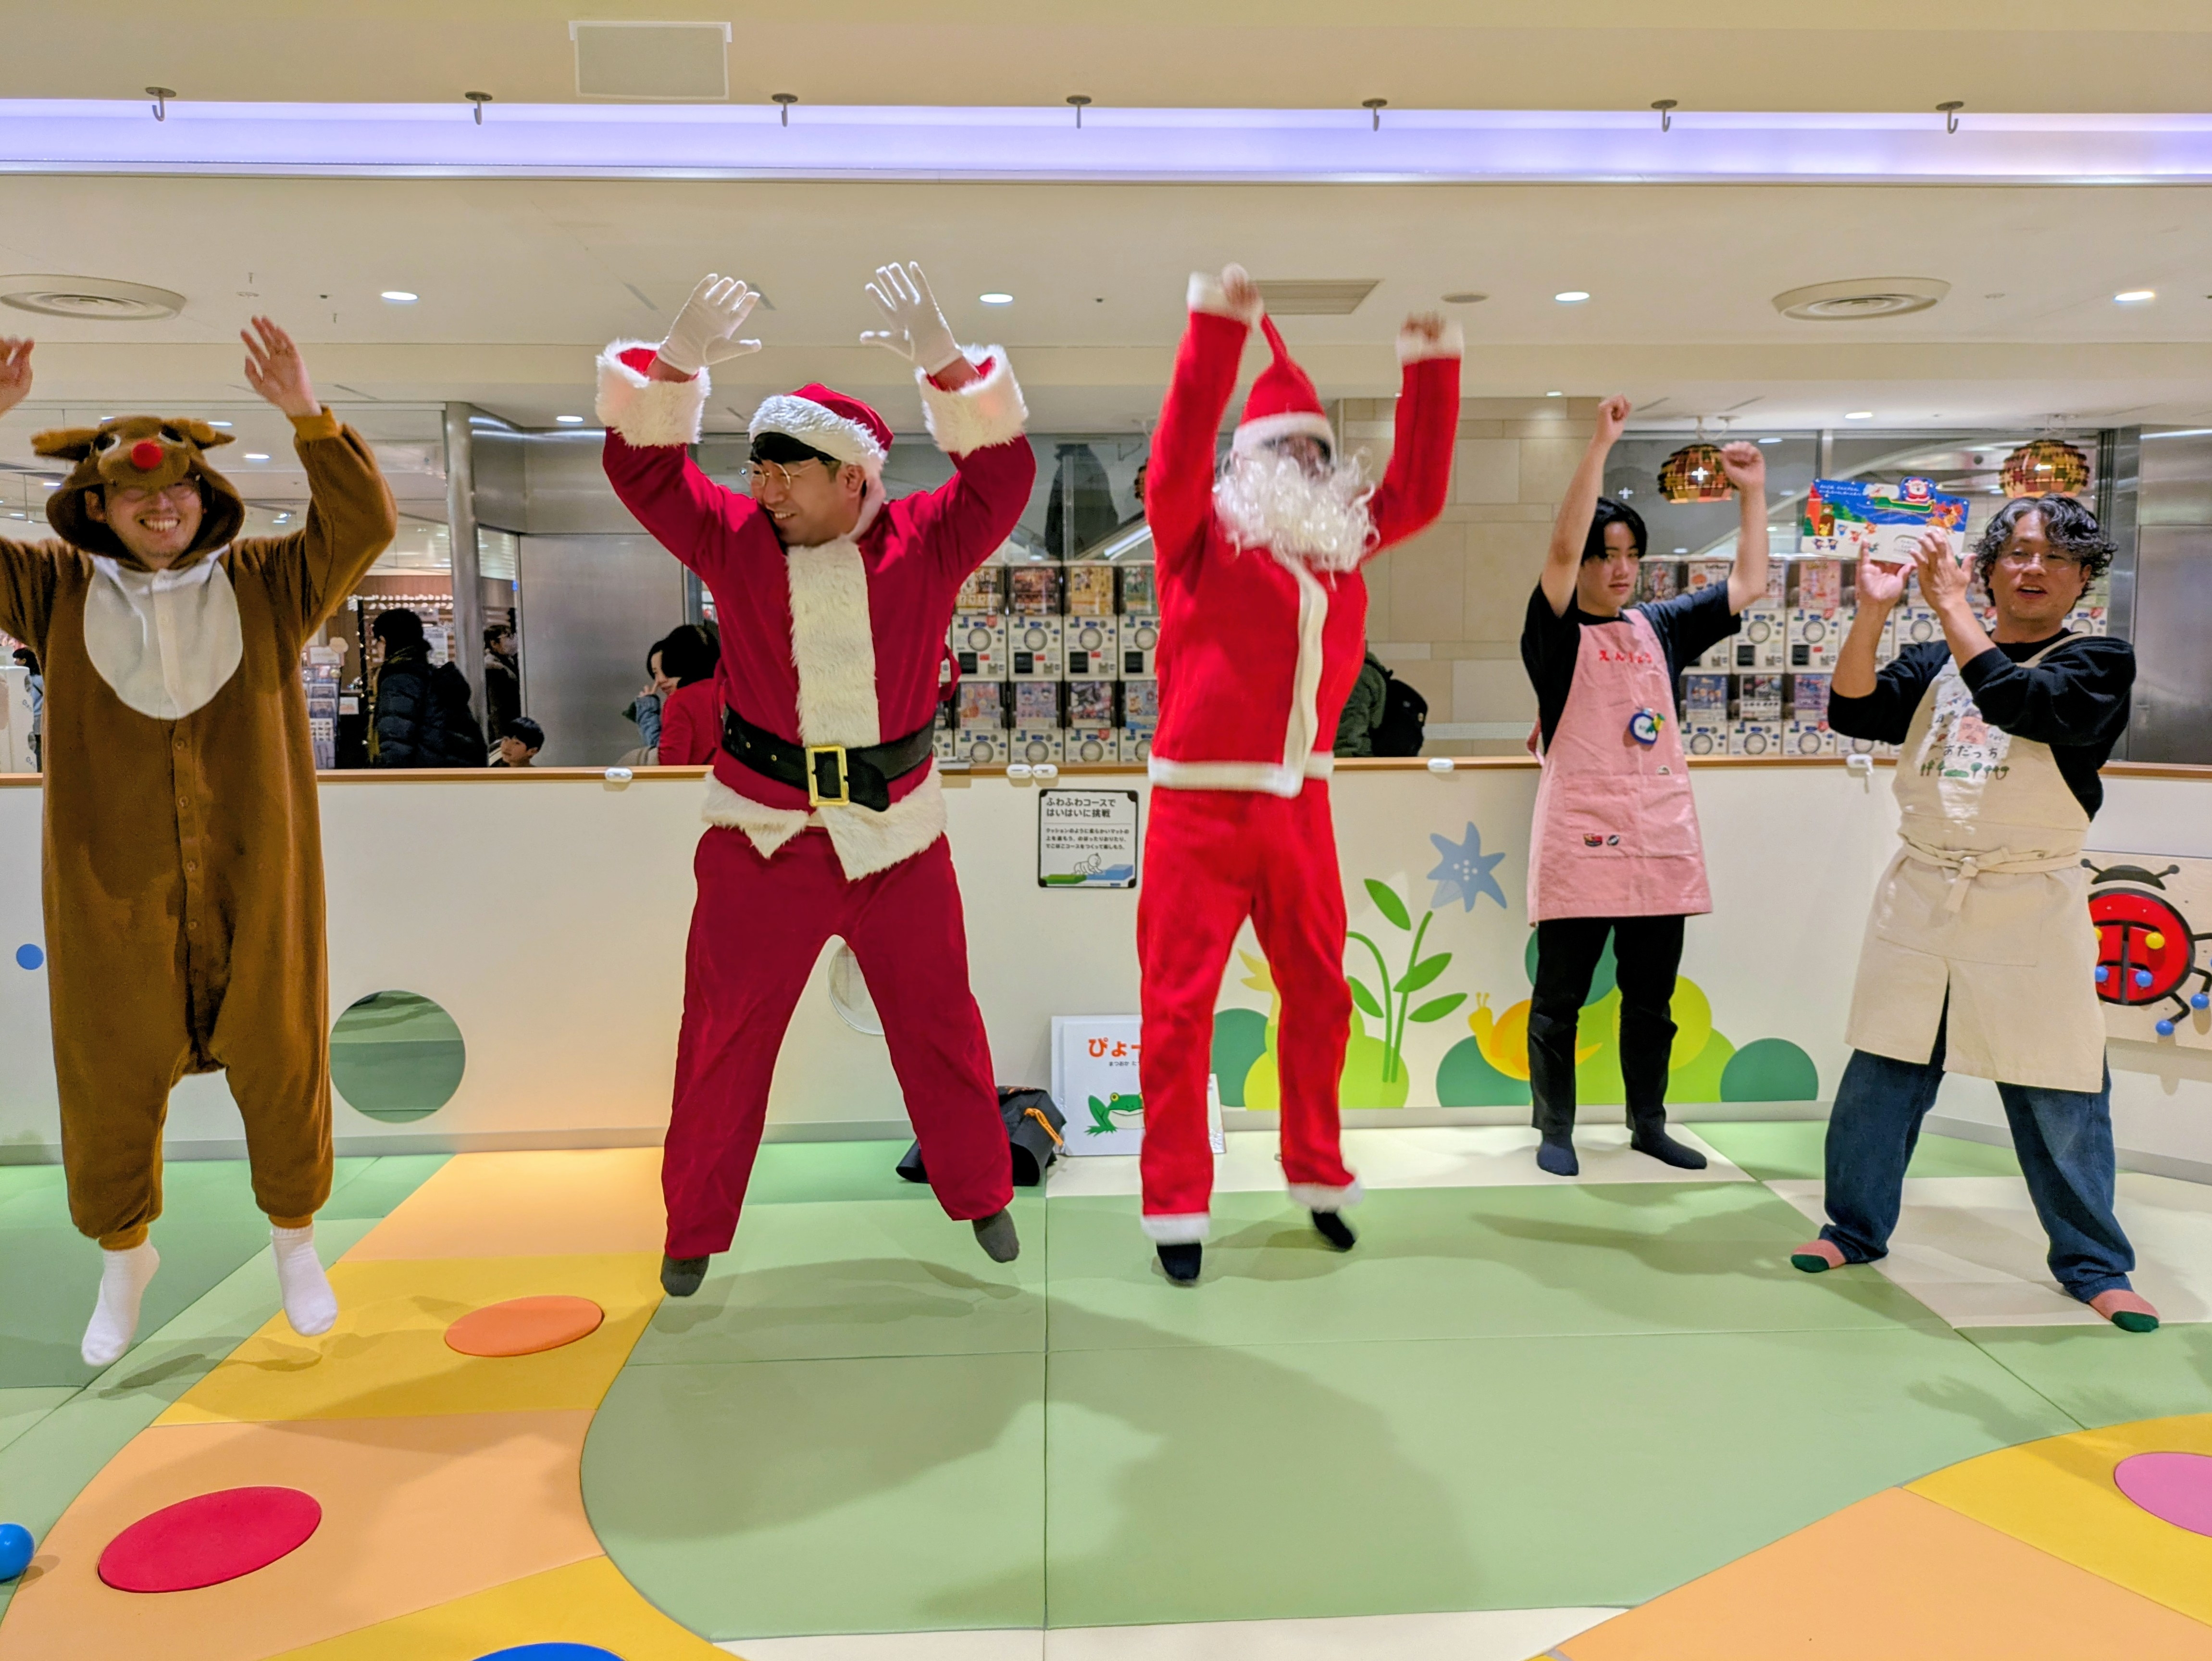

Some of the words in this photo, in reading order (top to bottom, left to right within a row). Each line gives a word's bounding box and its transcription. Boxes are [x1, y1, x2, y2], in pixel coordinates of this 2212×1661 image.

[1046, 797, 1116, 807] ふわふわコースで
[1046, 809, 1111, 818] はいはいに挑戦
